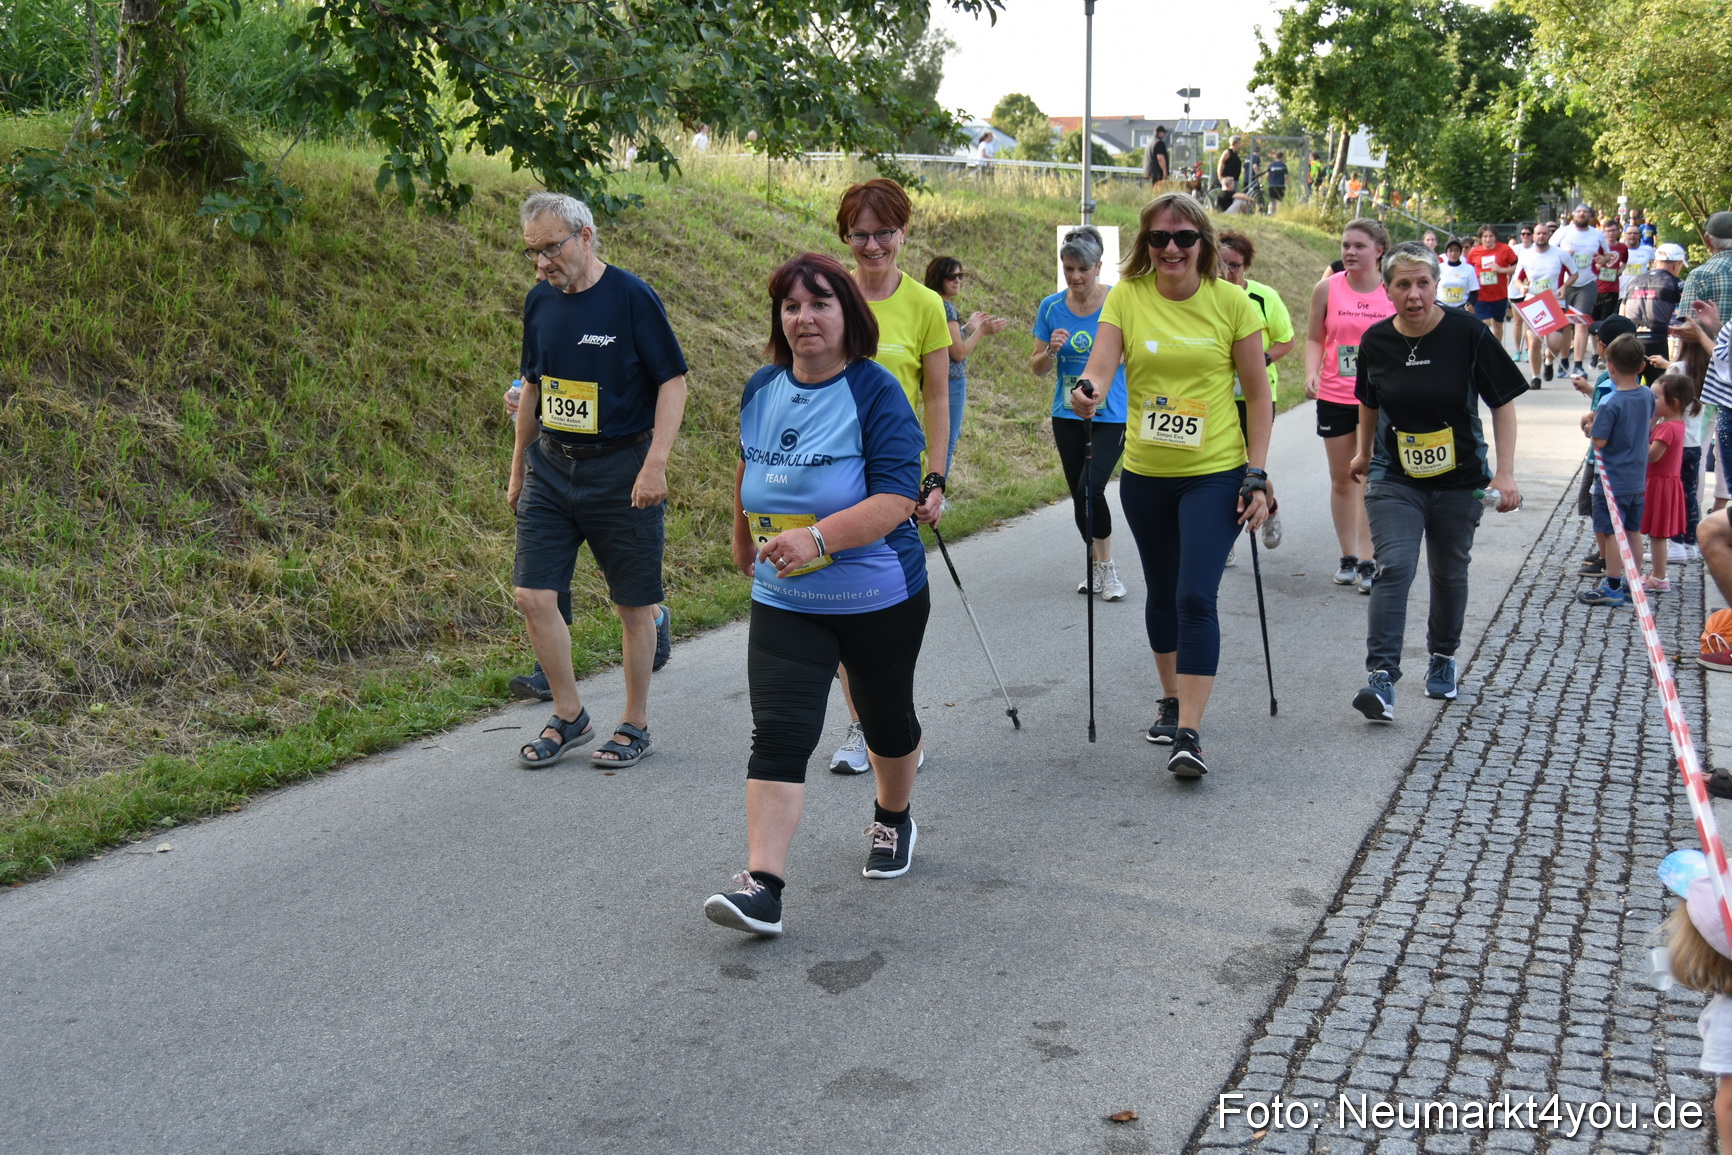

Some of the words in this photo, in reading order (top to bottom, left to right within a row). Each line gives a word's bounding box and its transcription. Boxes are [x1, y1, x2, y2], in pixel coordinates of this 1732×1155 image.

[1357, 301, 1370, 310] Die
[546, 395, 589, 419] 1394
[1147, 412, 1198, 435] 1295
[1156, 431, 1173, 439] Simon
[745, 446, 834, 467] SCHABMÜLLER
[1404, 446, 1447, 466] 1980
[765, 473, 788, 484] TEAM
[762, 580, 880, 601] www.schabmueller.de
